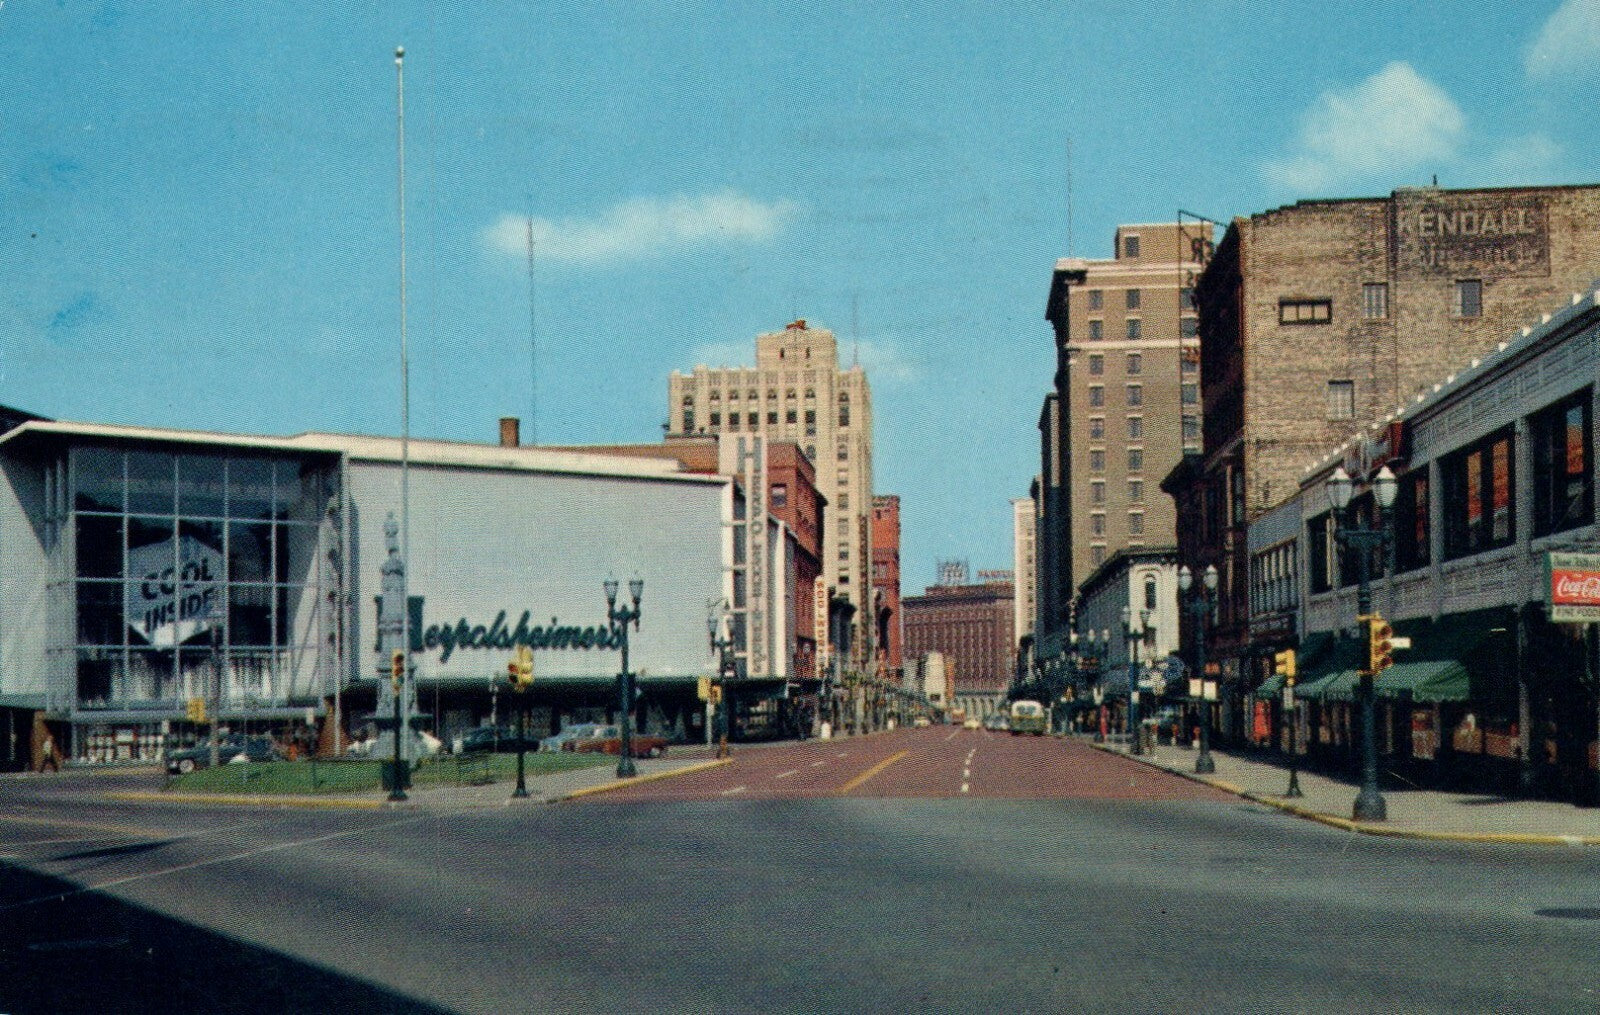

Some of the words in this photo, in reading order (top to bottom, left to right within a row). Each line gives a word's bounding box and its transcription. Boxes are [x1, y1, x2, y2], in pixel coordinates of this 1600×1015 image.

[1397, 206, 1537, 236] KENDALL
[141, 558, 213, 600] COOL
[145, 587, 214, 634] INSIDE
